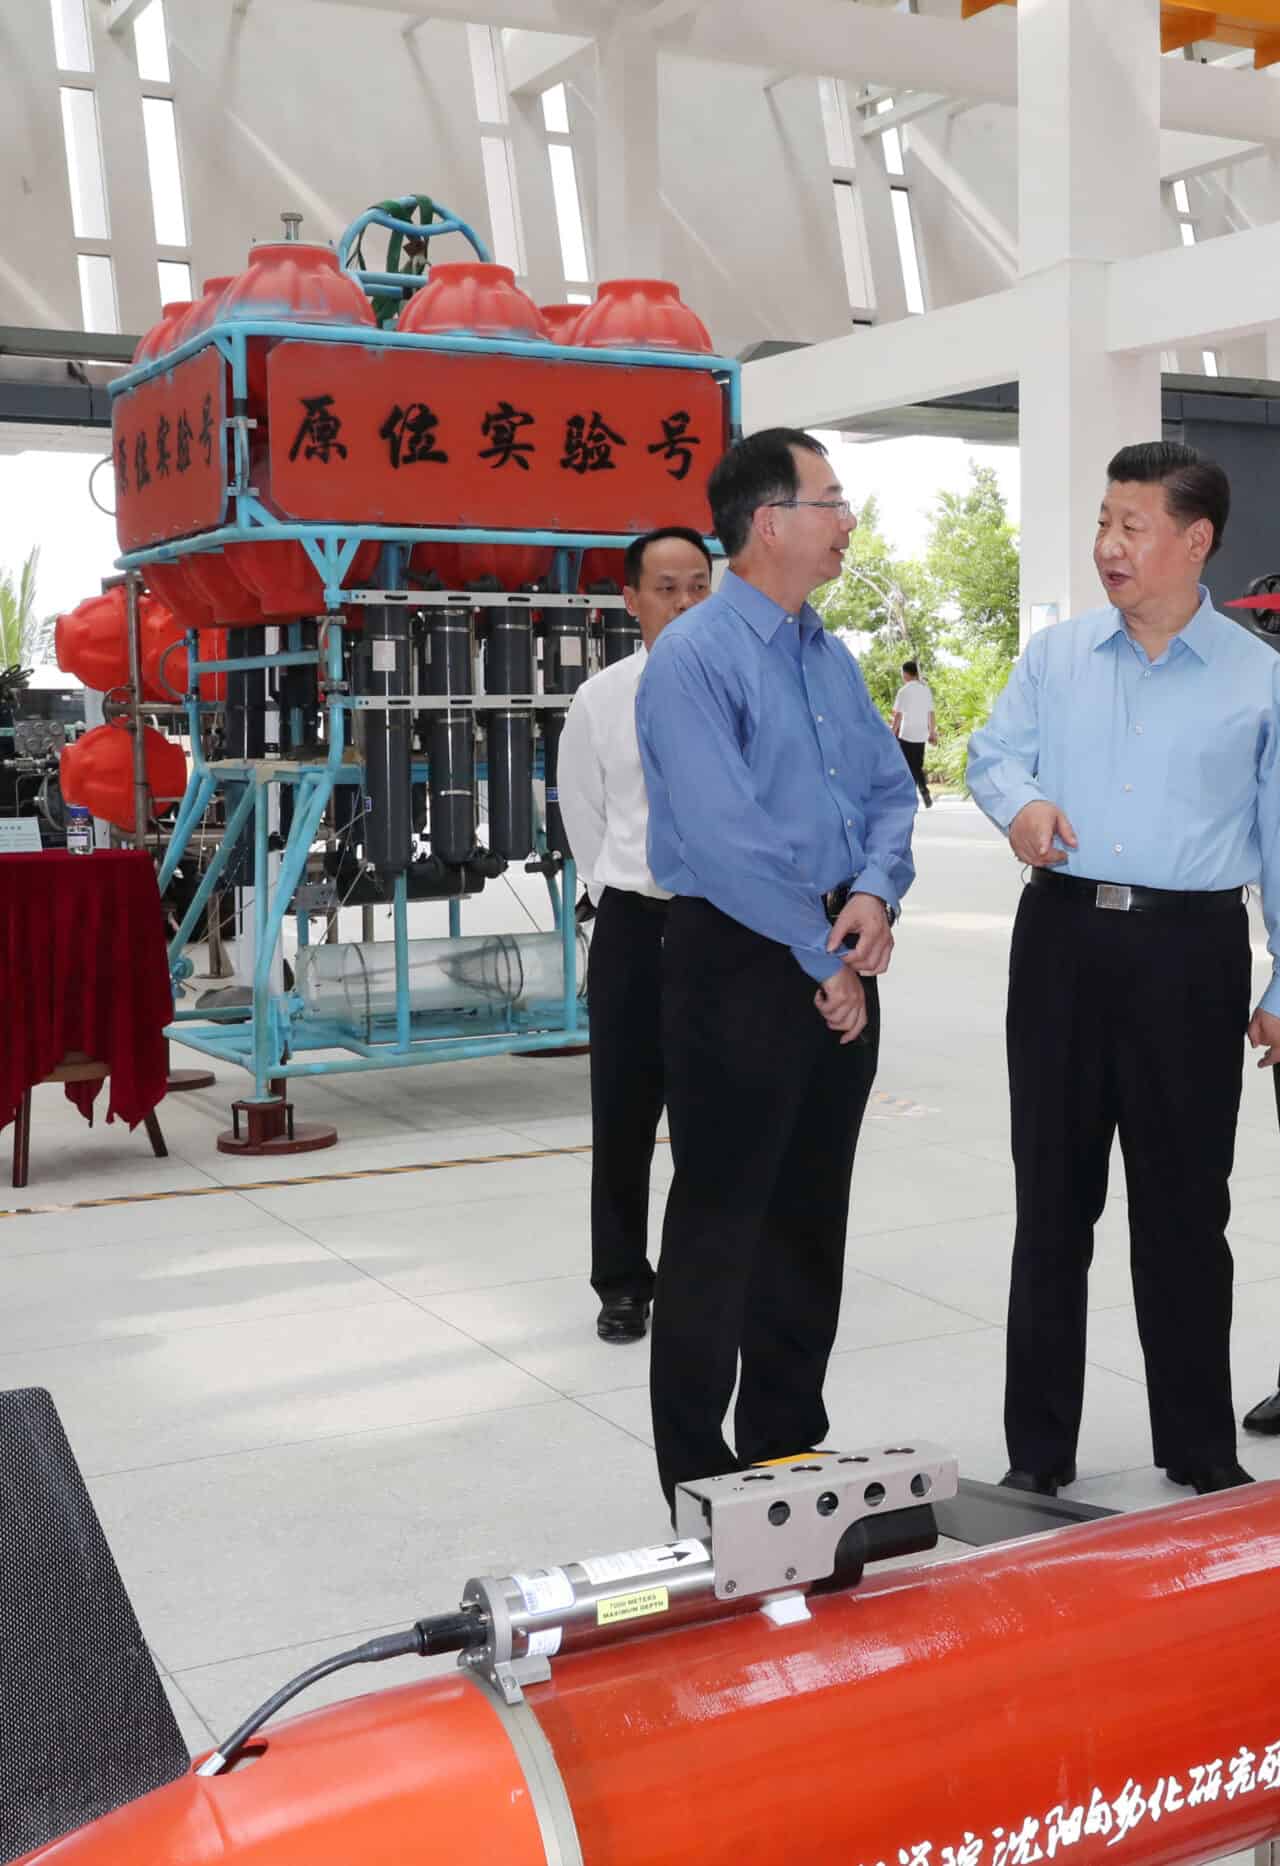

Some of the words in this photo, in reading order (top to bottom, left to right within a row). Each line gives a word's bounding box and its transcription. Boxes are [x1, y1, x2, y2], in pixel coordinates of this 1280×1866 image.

[288, 393, 701, 481] 原位实验号
